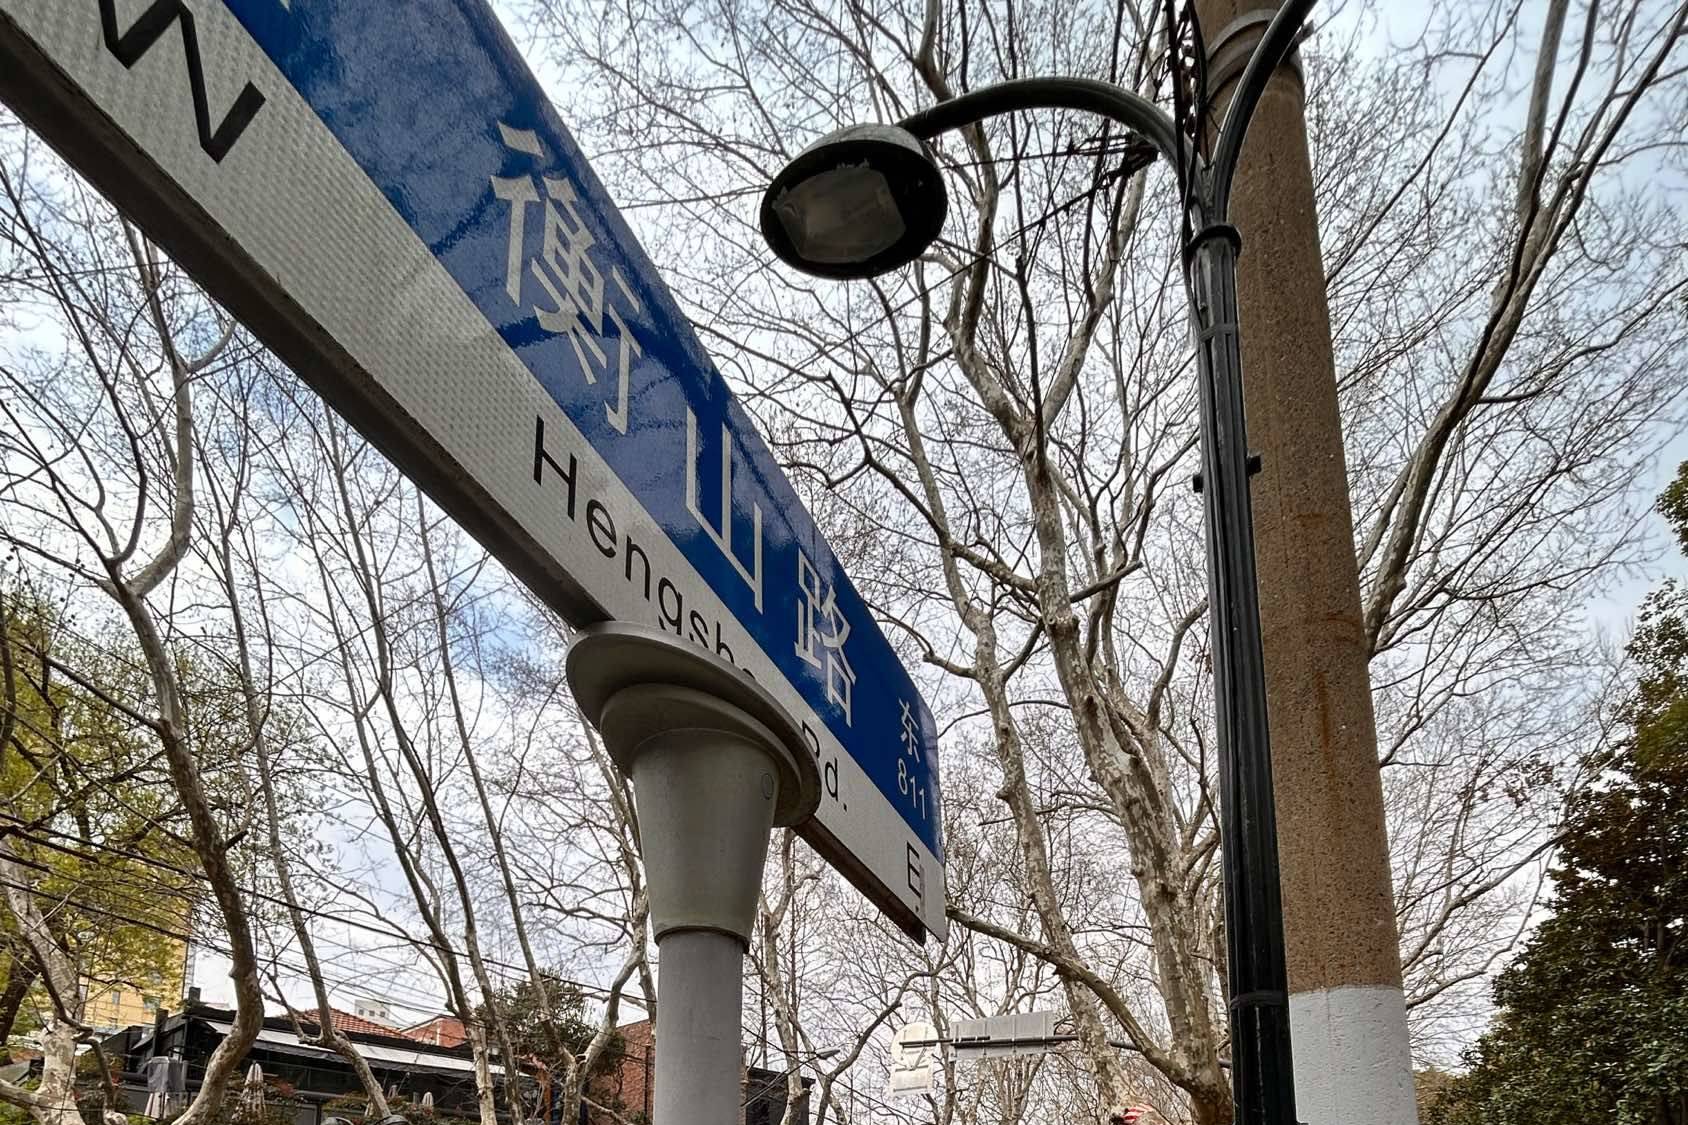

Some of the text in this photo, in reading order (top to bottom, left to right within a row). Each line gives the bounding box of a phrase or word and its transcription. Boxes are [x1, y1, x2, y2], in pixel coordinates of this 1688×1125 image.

[102, 0, 266, 163] W
[491, 120, 857, 728] 衡山路
[533, 414, 756, 680] Hengsh
[898, 758, 926, 821] 811
[899, 698, 919, 763] 东
